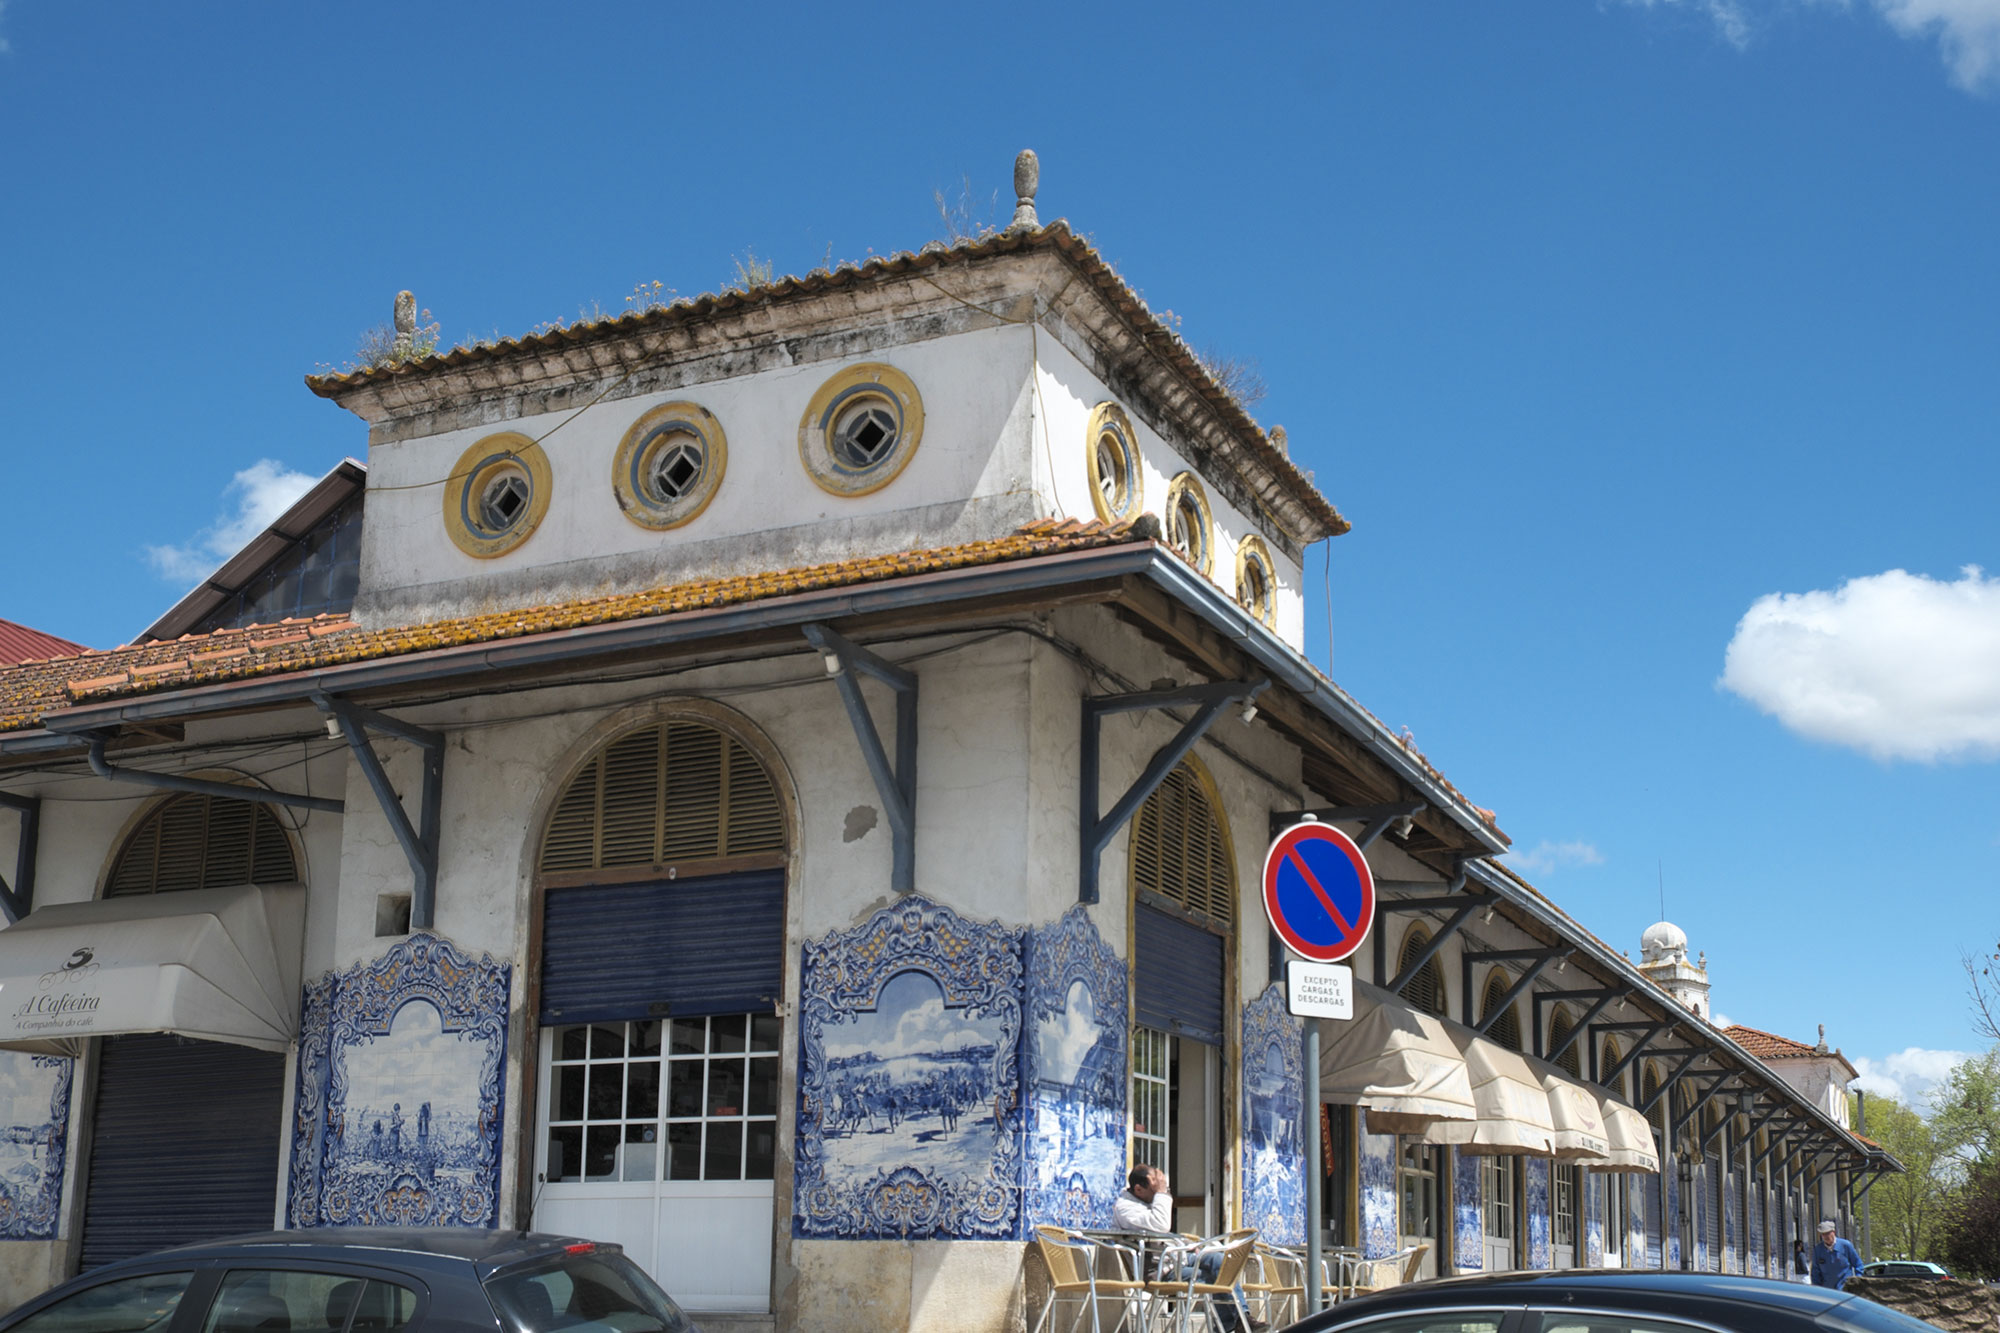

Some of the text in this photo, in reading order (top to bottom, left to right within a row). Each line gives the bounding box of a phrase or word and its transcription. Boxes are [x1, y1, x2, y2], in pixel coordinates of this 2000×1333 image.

[1304, 976, 1338, 986] EXCEPTO
[1302, 985, 1333, 996] CARGAS
[1298, 994, 1344, 1006] DESCARGAS
[12, 996, 36, 1020] A
[15, 1022, 21, 1030] A
[22, 1018, 63, 1031] Companhia
[65, 1018, 75, 1027] do
